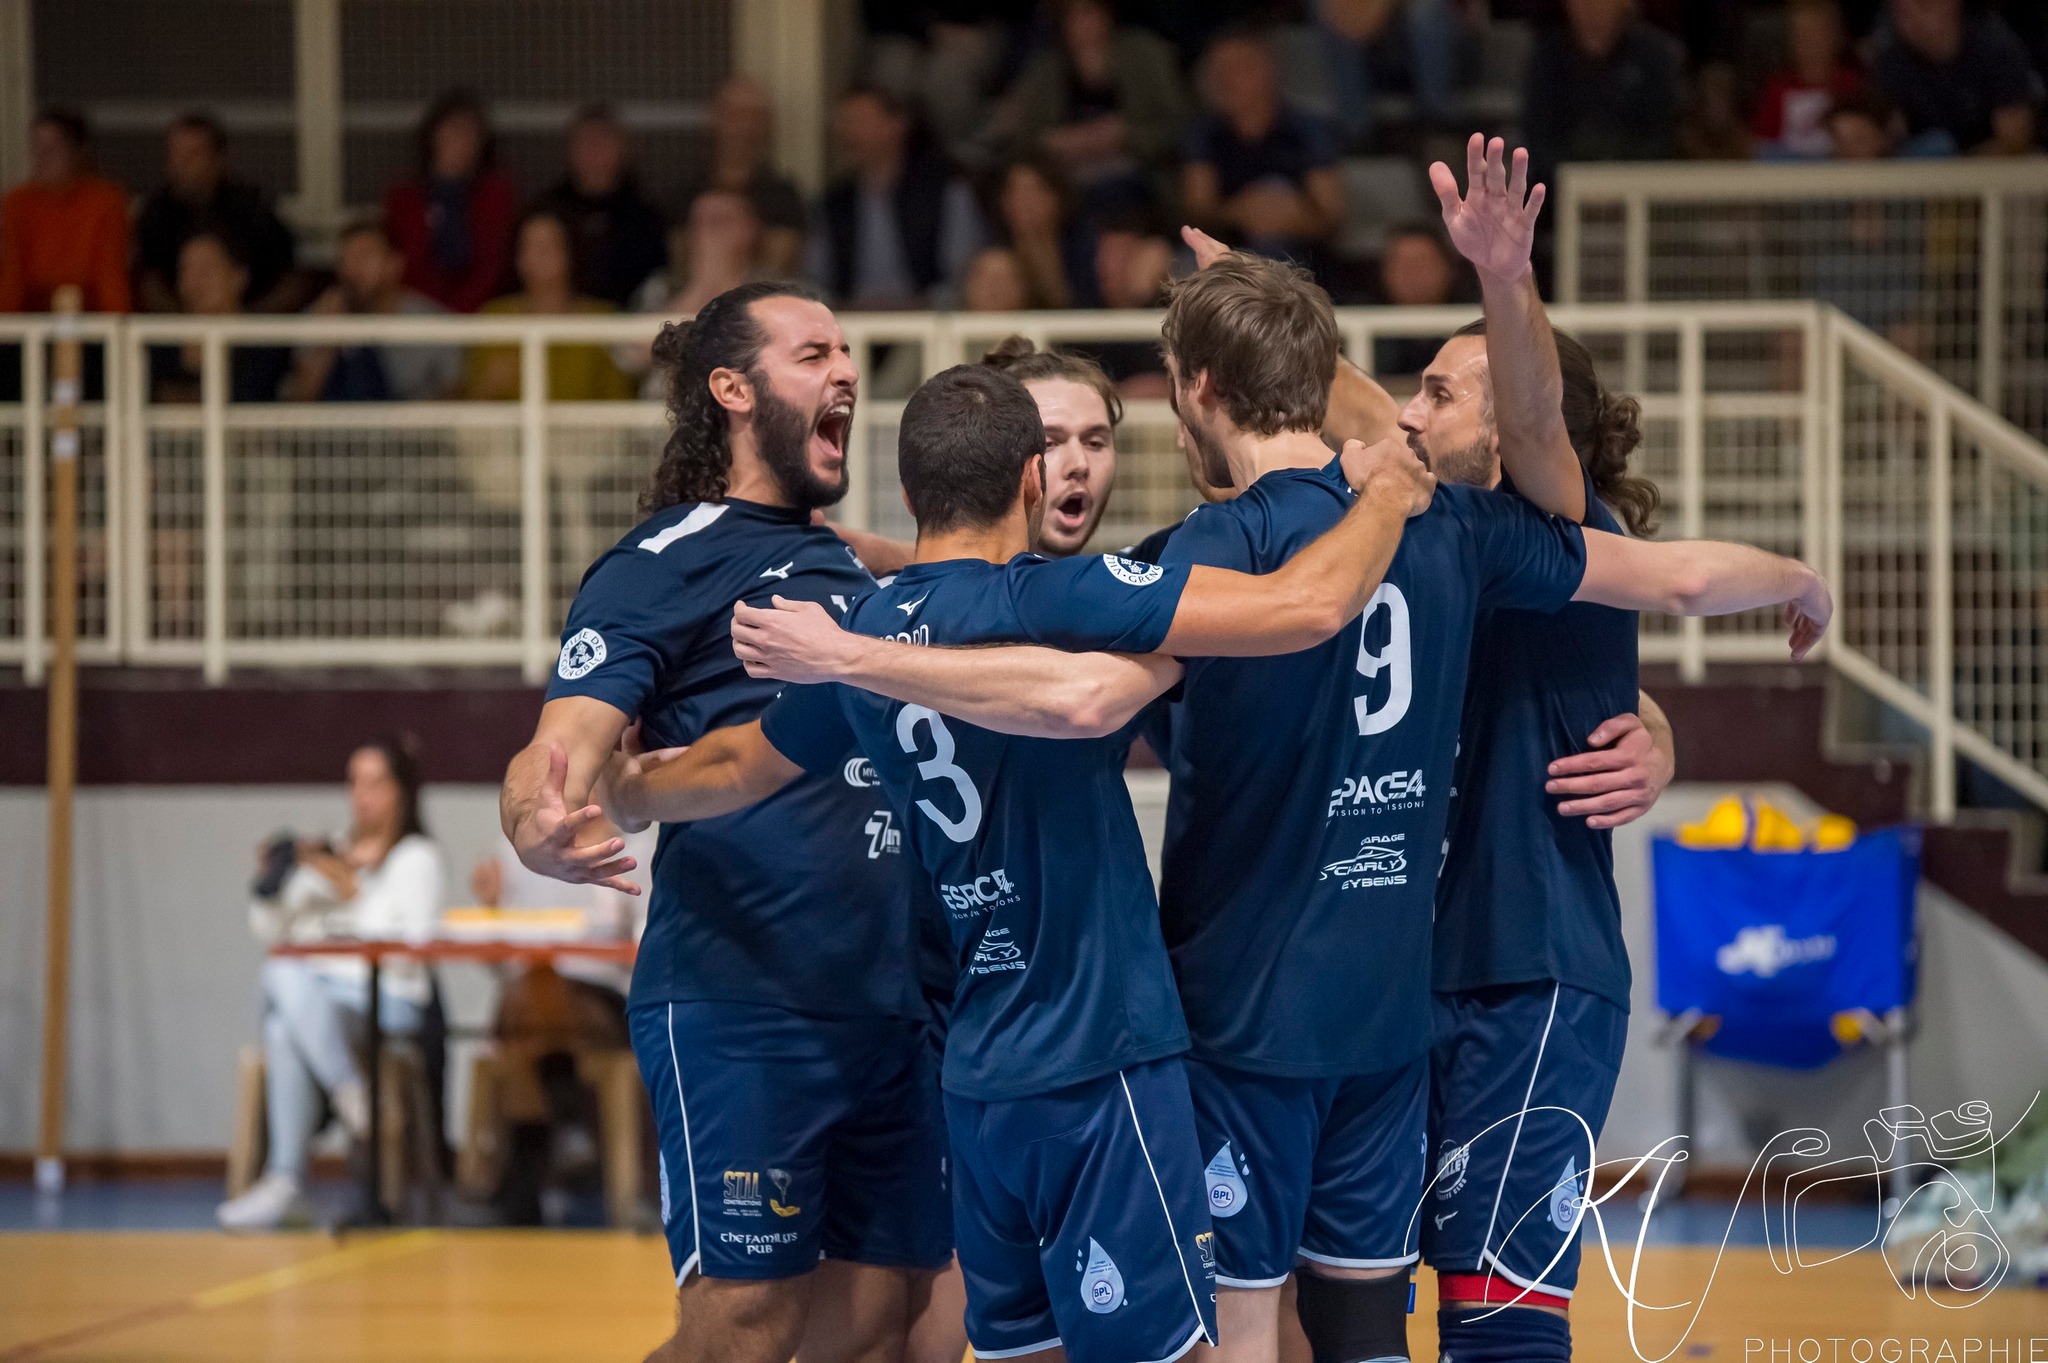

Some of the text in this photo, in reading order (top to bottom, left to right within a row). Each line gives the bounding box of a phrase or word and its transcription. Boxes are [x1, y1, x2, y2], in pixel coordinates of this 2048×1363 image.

[1354, 582, 1411, 736] 9
[896, 702, 982, 843] 3
[1341, 875, 1408, 890] EYBENS
[1212, 1189, 1231, 1201] BPL
[1094, 1286, 1110, 1298] BPL
